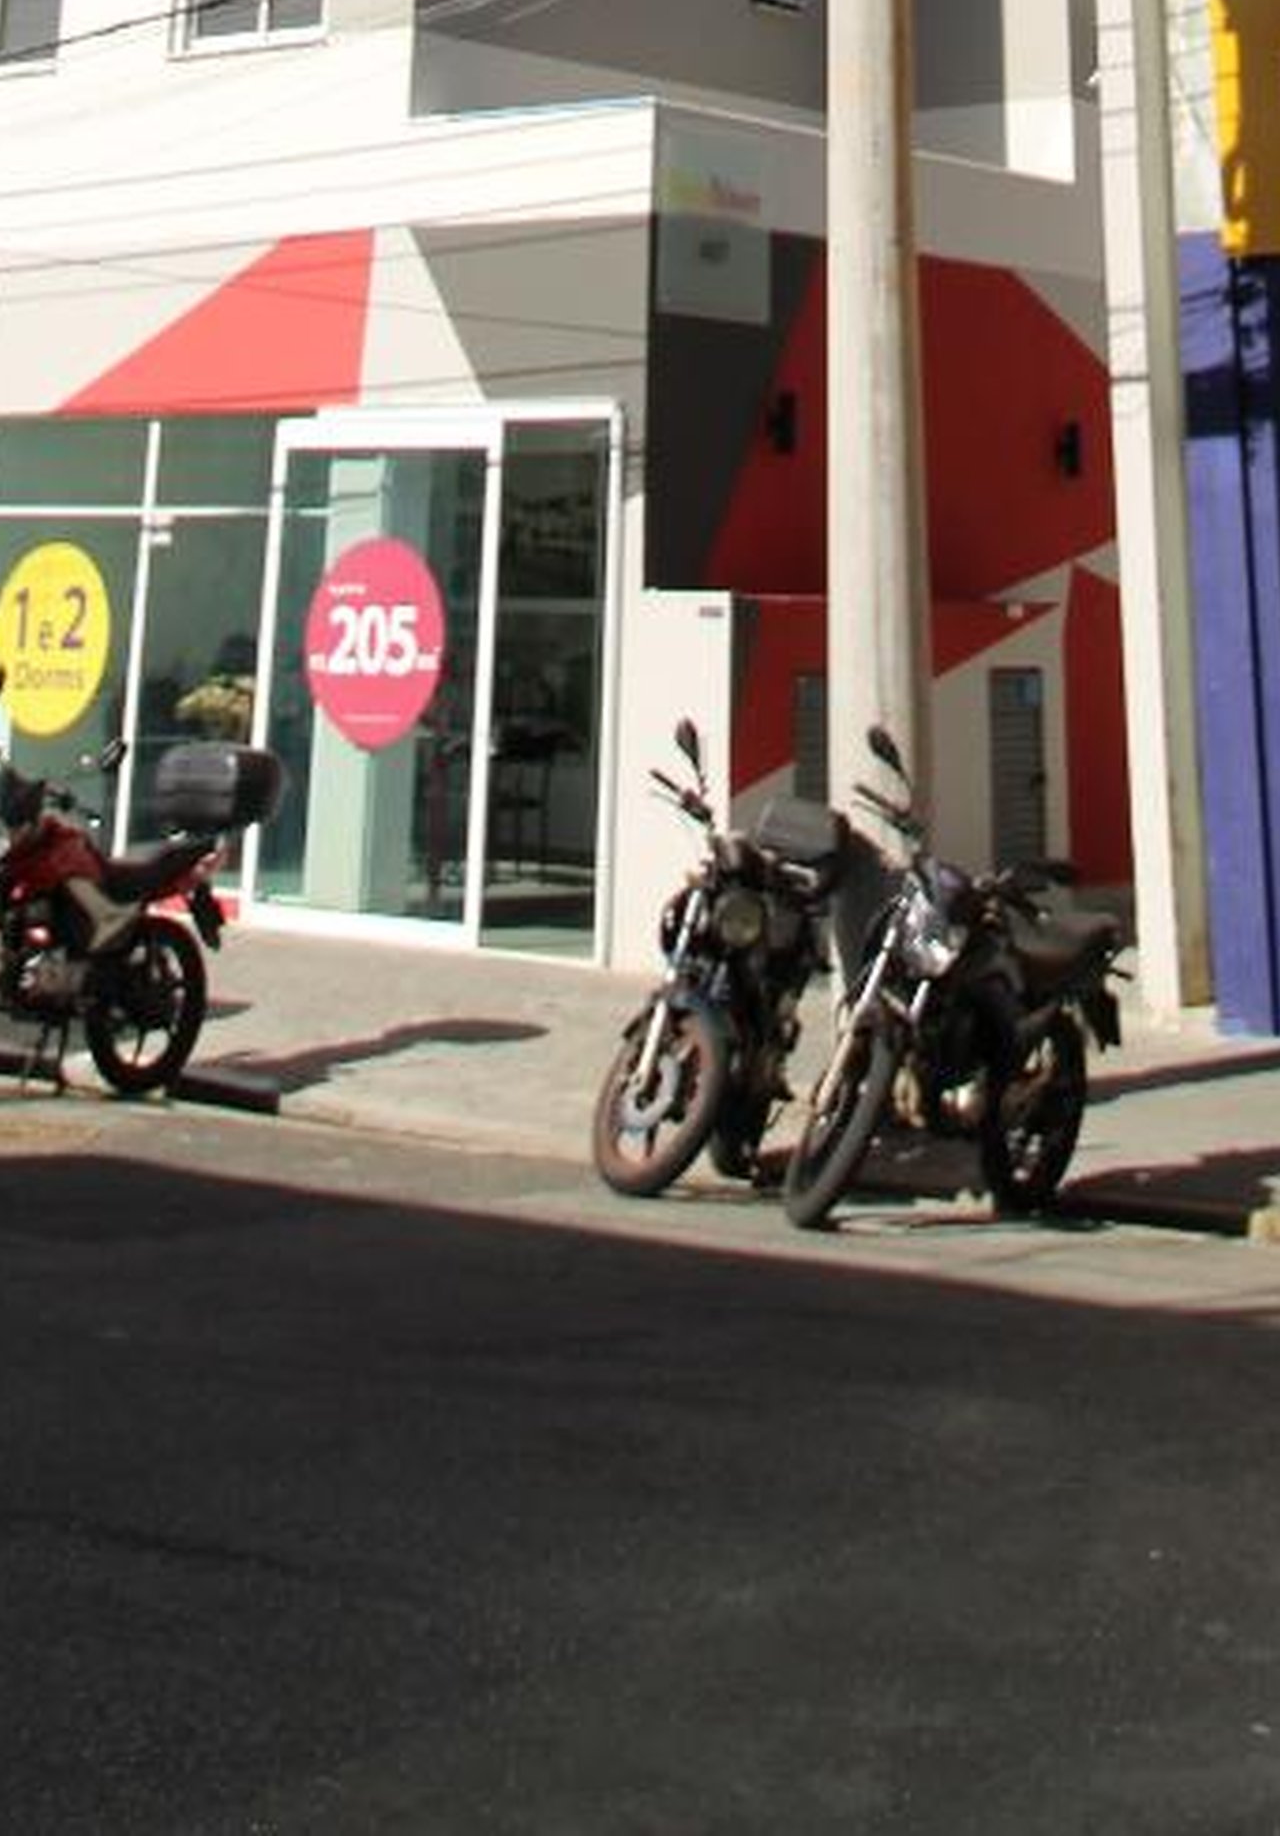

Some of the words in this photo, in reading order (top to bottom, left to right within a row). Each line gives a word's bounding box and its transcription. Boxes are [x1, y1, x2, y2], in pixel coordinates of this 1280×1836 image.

[15, 587, 30, 649] 1
[60, 585, 87, 649] 2
[327, 604, 419, 676] 205
